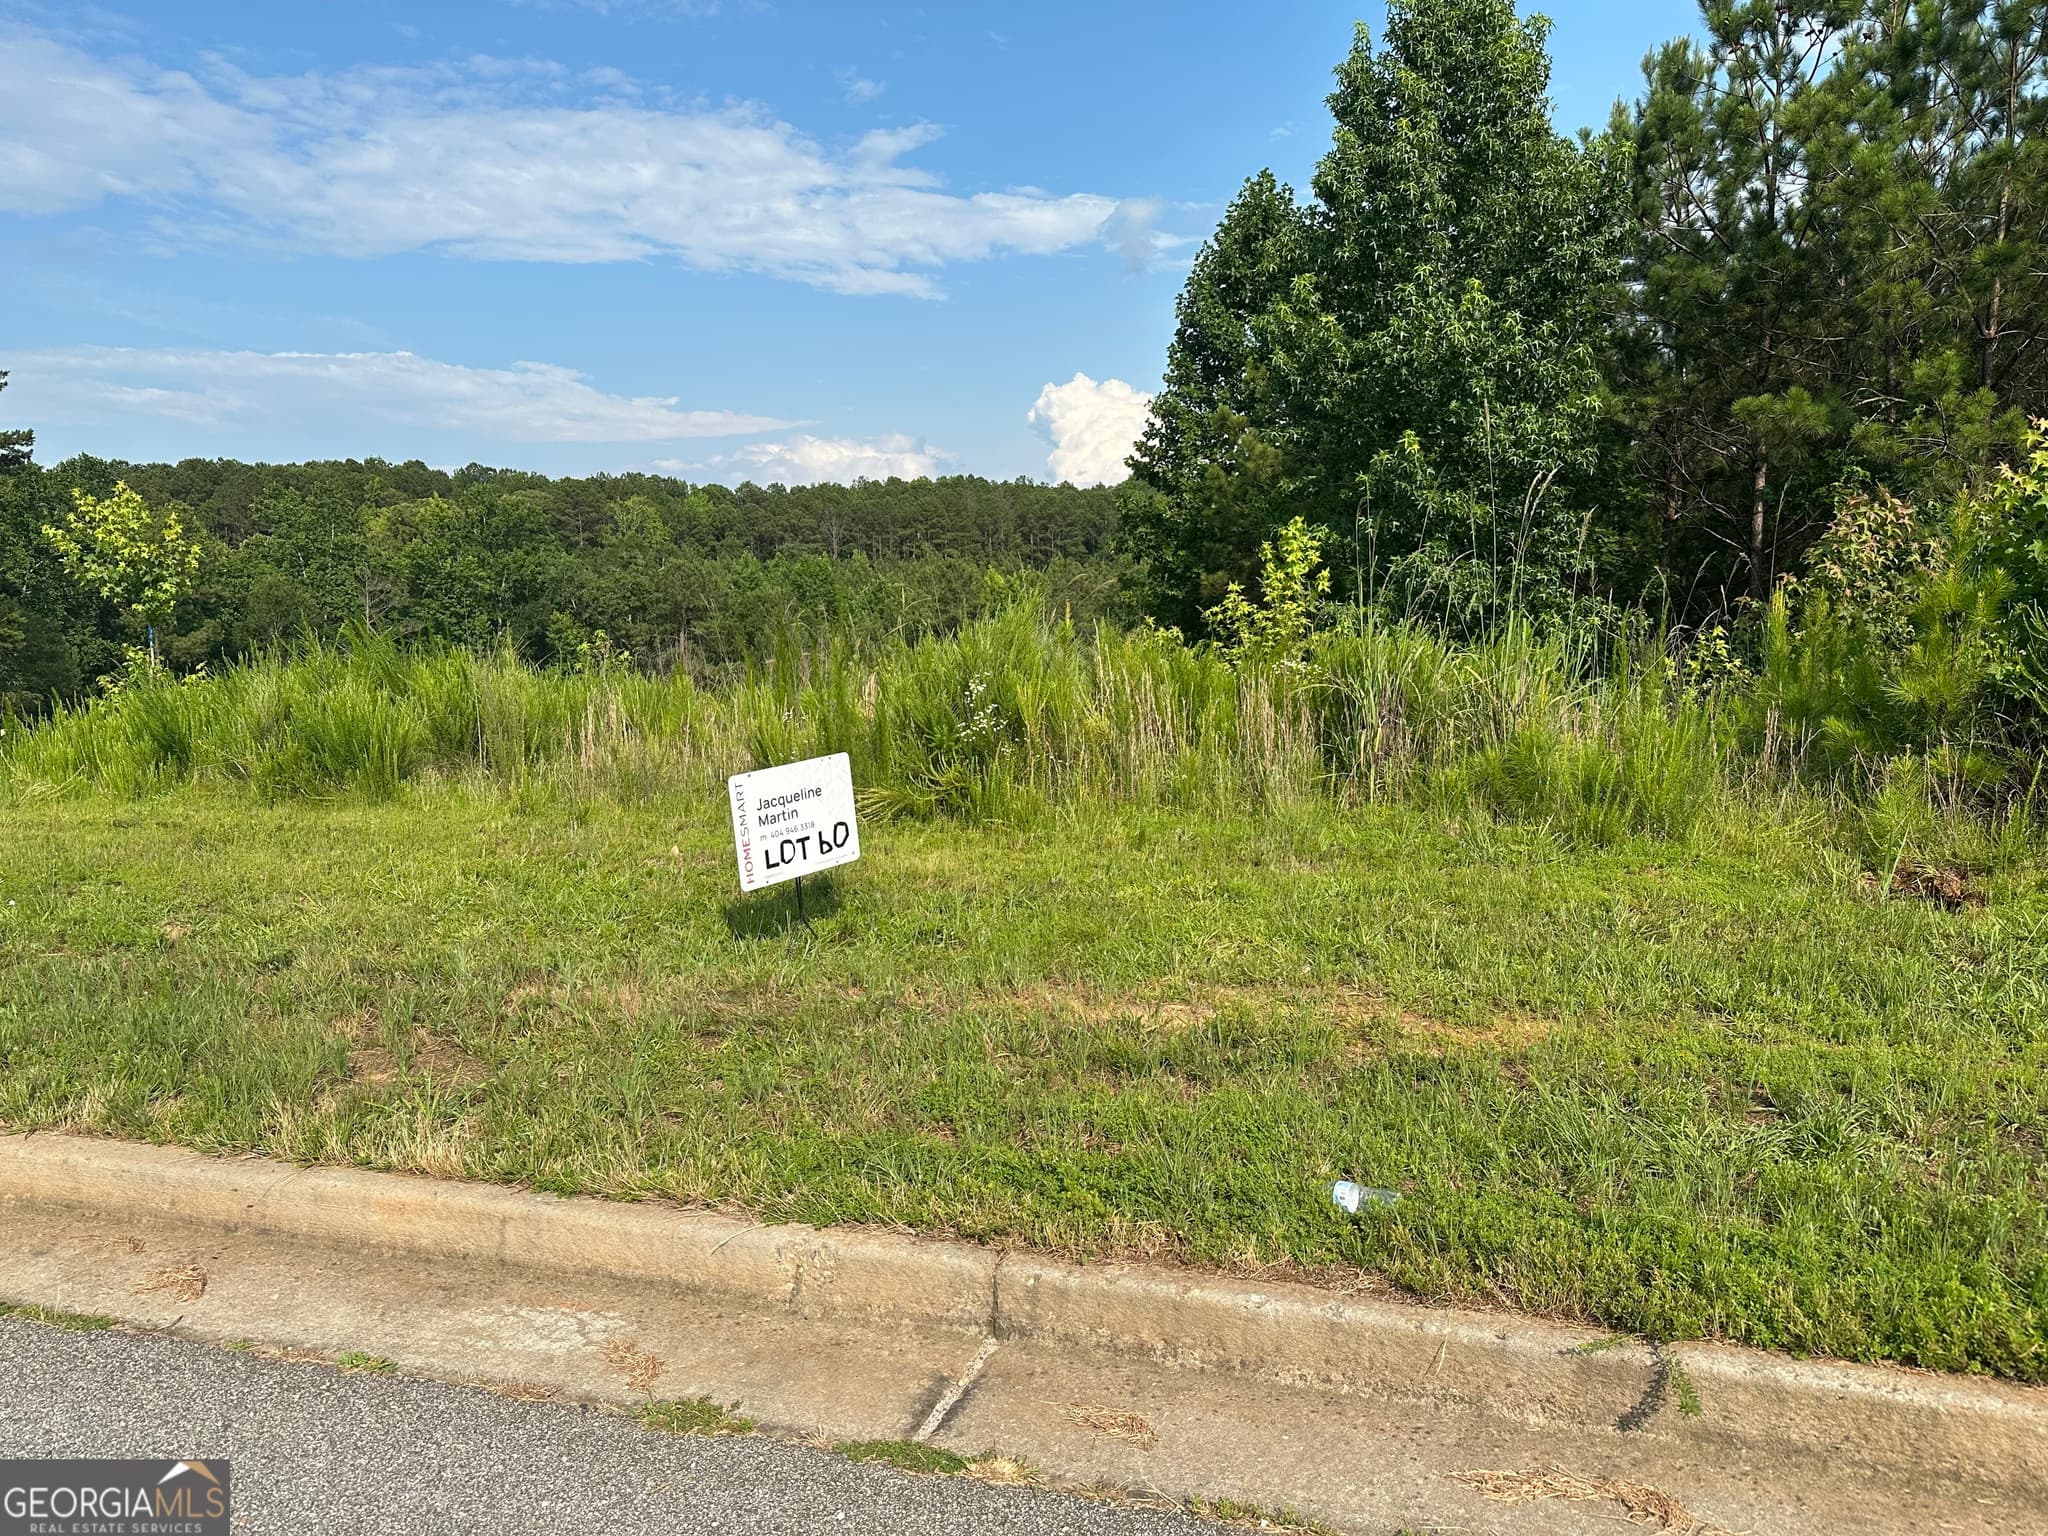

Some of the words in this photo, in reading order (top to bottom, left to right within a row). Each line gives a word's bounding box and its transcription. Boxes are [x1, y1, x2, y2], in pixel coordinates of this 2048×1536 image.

[757, 787, 822, 811] Jacqueline
[758, 809, 798, 827] Martin
[735, 783, 755, 884] HOMESMART
[770, 829, 784, 838] 404
[765, 836, 810, 869] LOT
